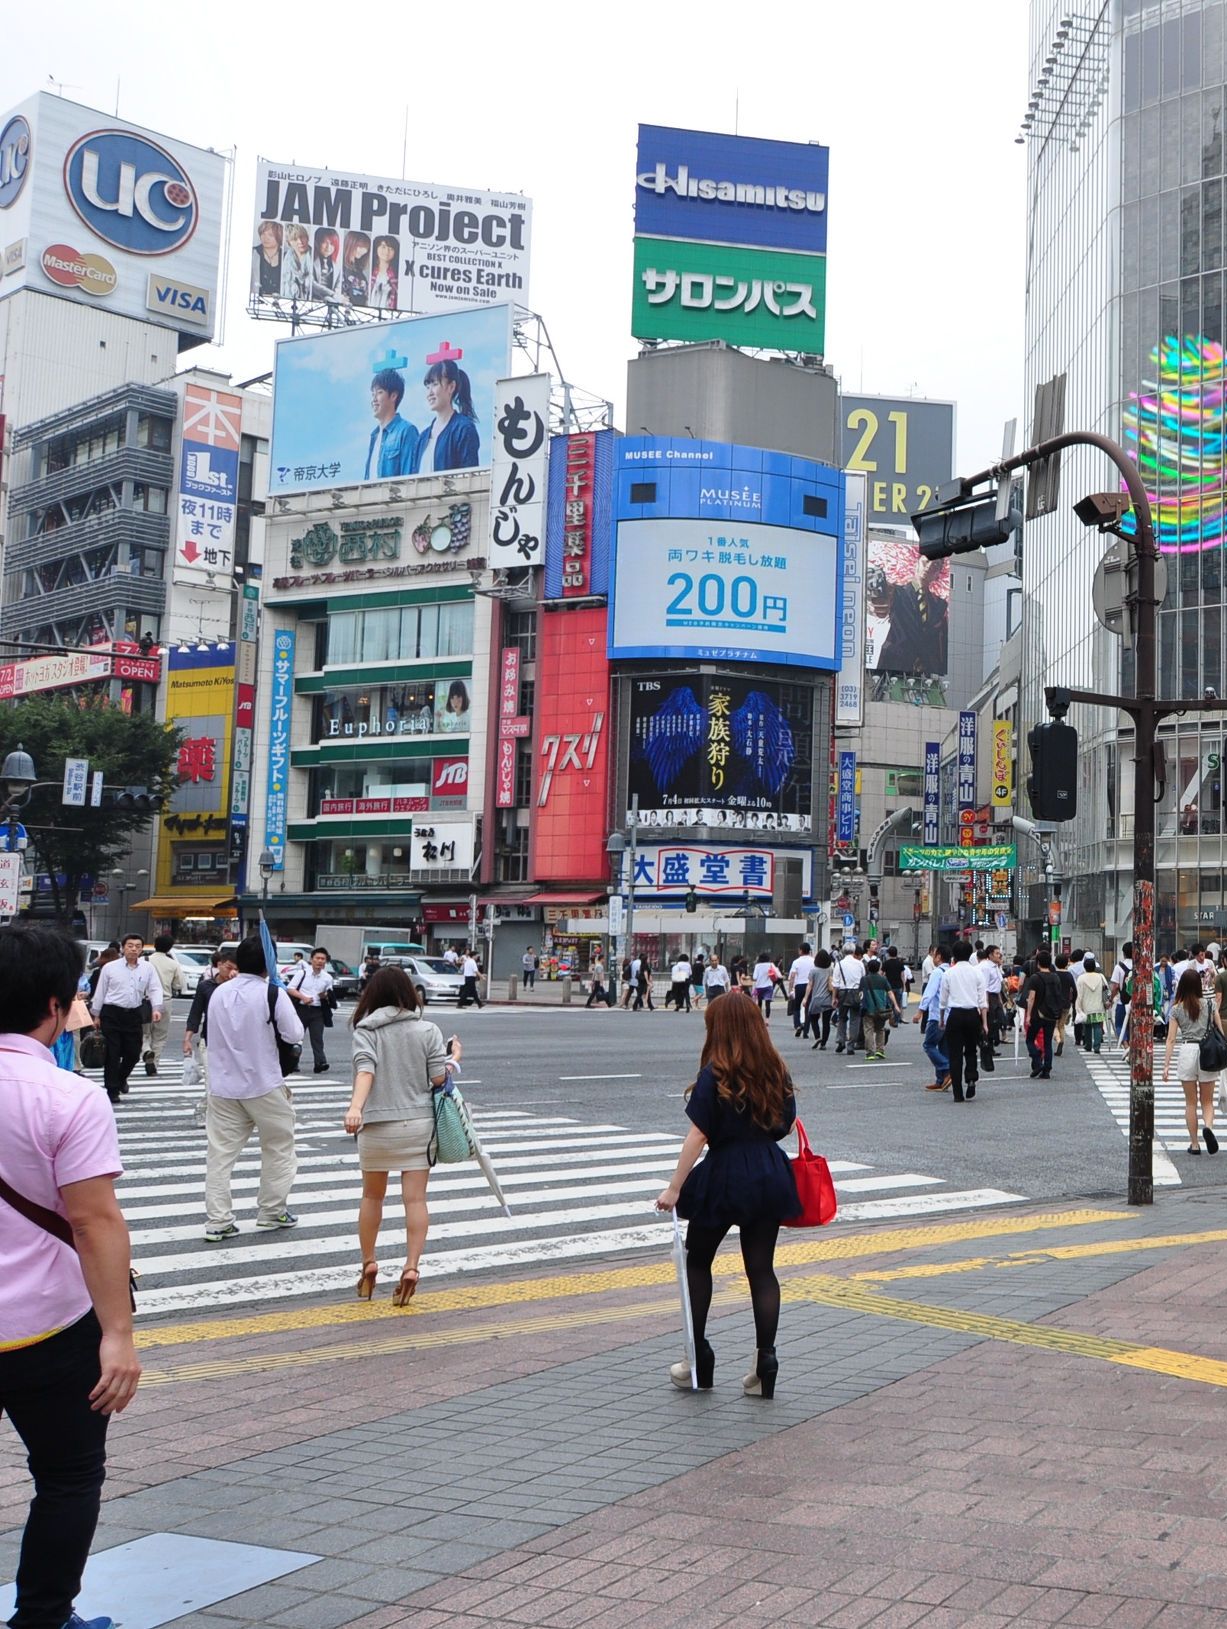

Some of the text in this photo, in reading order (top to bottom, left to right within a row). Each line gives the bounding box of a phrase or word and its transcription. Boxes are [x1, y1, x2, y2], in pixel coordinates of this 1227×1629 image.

[376, 184, 439, 200] きただにひろし
[637, 162, 825, 212] Hisamitsu
[260, 179, 525, 250] JAM Project
[412, 241, 519, 262] アニソン界のスーパーユニット
[427, 252, 447, 264] BEST
[448, 254, 497, 269] COLLECTION
[43, 255, 115, 285] MasterCard
[419, 264, 472, 284] cures
[476, 268, 523, 290] Earth
[155, 285, 207, 315] VISA
[430, 281, 497, 299] Now on Sale
[641, 267, 817, 319] サロンパス
[183, 390, 241, 446] 本
[625, 450, 714, 461] MUSEE Channel
[846, 408, 908, 474] 21
[186, 451, 197, 480] BOOK
[293, 462, 341, 482] 帝京大学
[493, 396, 544, 560] もんじゃ
[181, 499, 233, 524] 夜11時
[700, 498, 762, 509] PLATINUM
[190, 520, 223, 540] まで
[204, 547, 232, 566] 地下
[339, 528, 401, 565] 西村
[666, 572, 788, 622] 200円
[841, 589, 856, 659] neon
[120, 665, 154, 679] OPEN
[171, 676, 213, 689] Matsumoto
[637, 681, 661, 691] TBS
[271, 660, 290, 782] サマーフルーツギフト
[329, 714, 428, 739] Euphoria
[707, 693, 731, 790] 家族狩り
[537, 712, 605, 807] クスリ
[959, 717, 976, 802] 洋服の青山
[435, 762, 468, 788] JTB
[841, 757, 854, 835] 大盛堂商事ビル
[924, 753, 940, 845] 洋服の青山
[995, 787, 1007, 796] 4F
